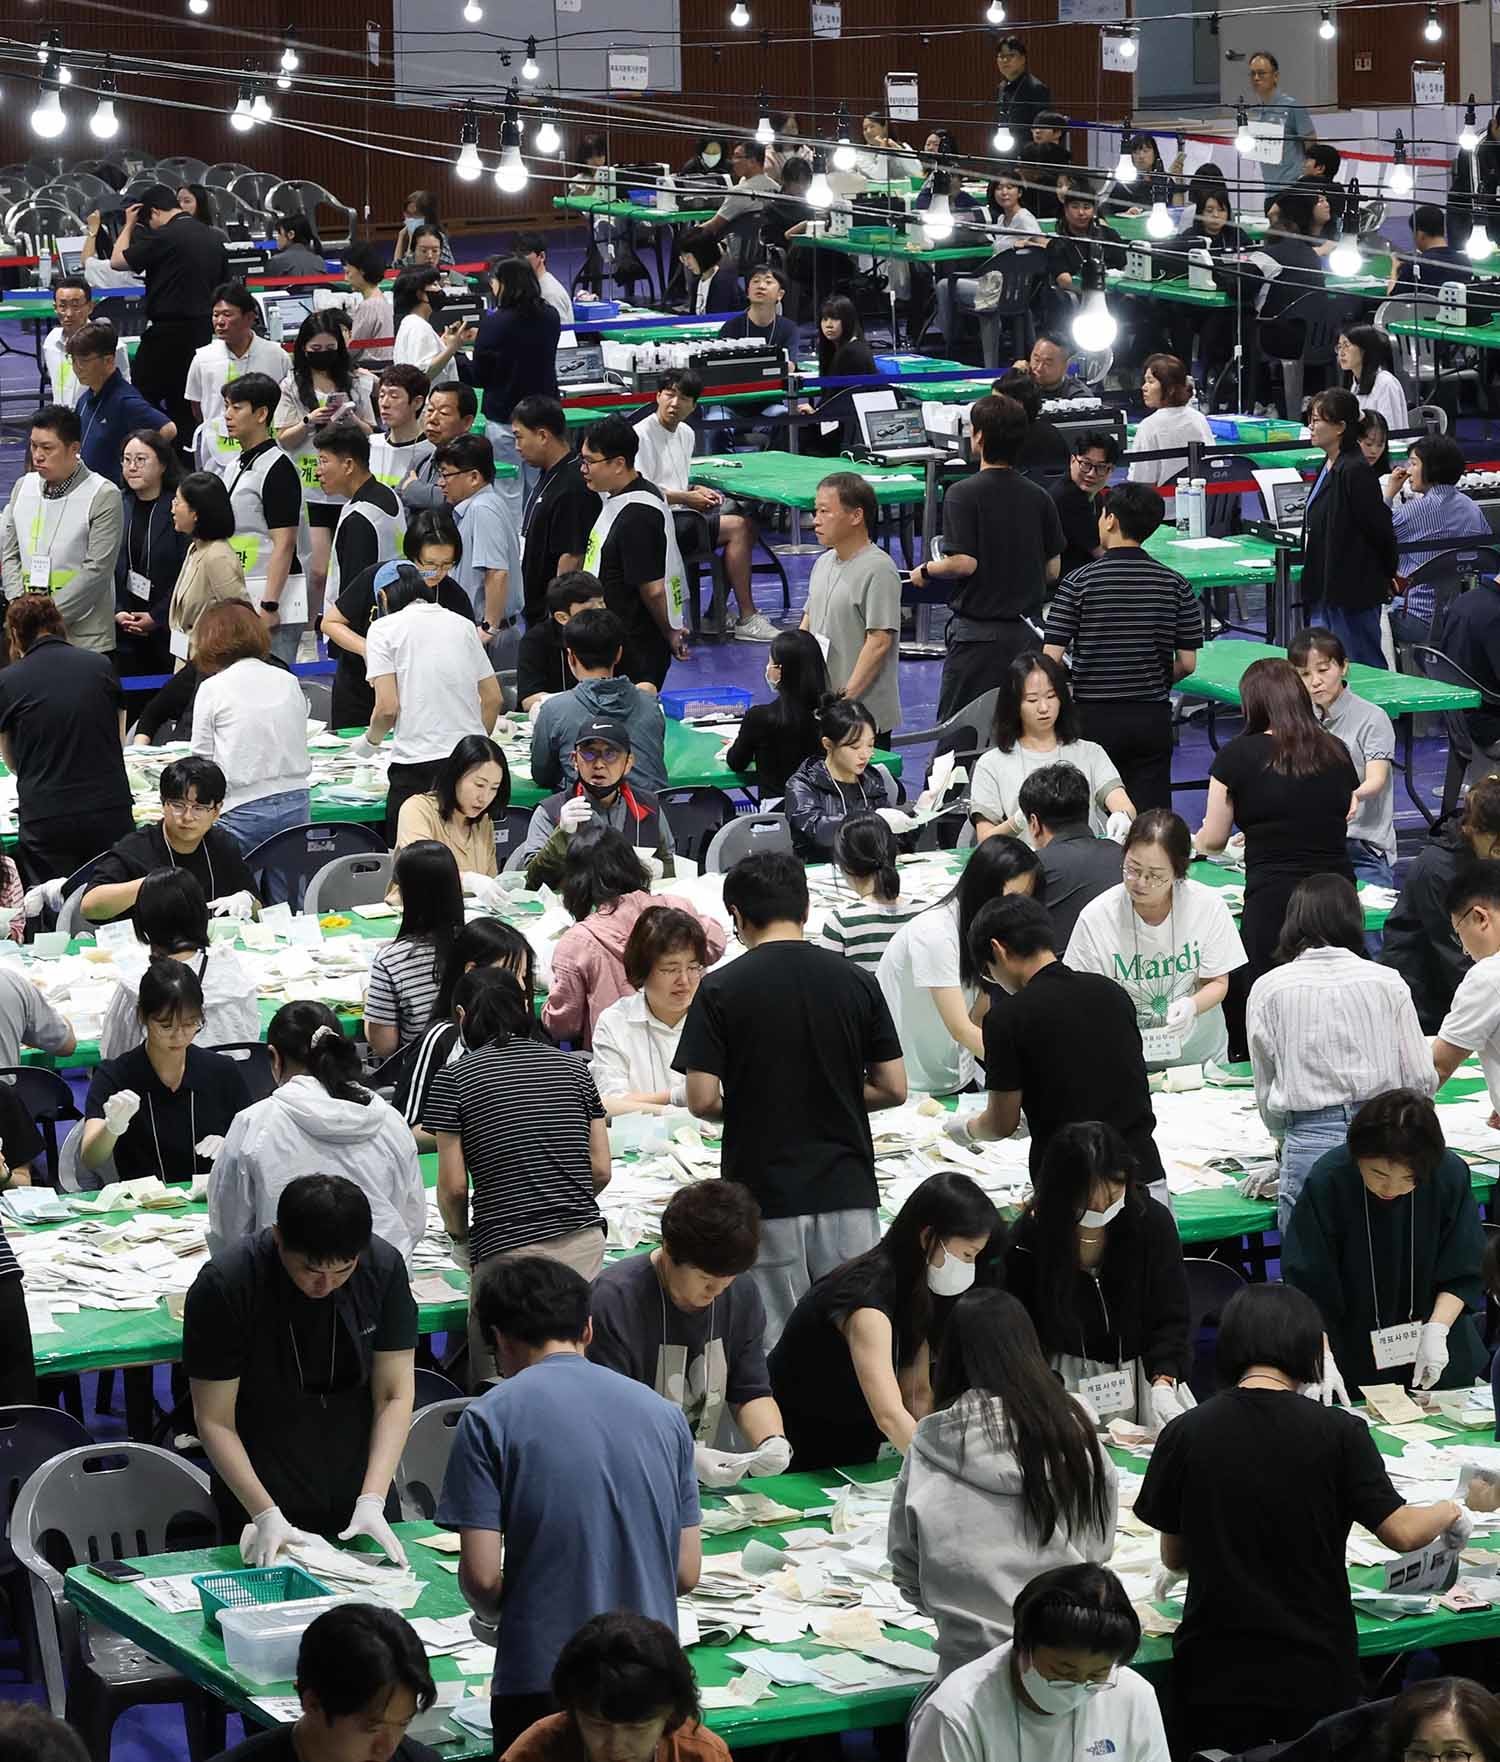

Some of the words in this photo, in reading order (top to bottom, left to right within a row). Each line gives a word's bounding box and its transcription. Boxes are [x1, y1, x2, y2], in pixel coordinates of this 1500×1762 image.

[1112, 940, 1200, 980] Mardi
[1379, 1330, 1418, 1344] 개표사무원
[1087, 1377, 1126, 1392] 개표사무원
